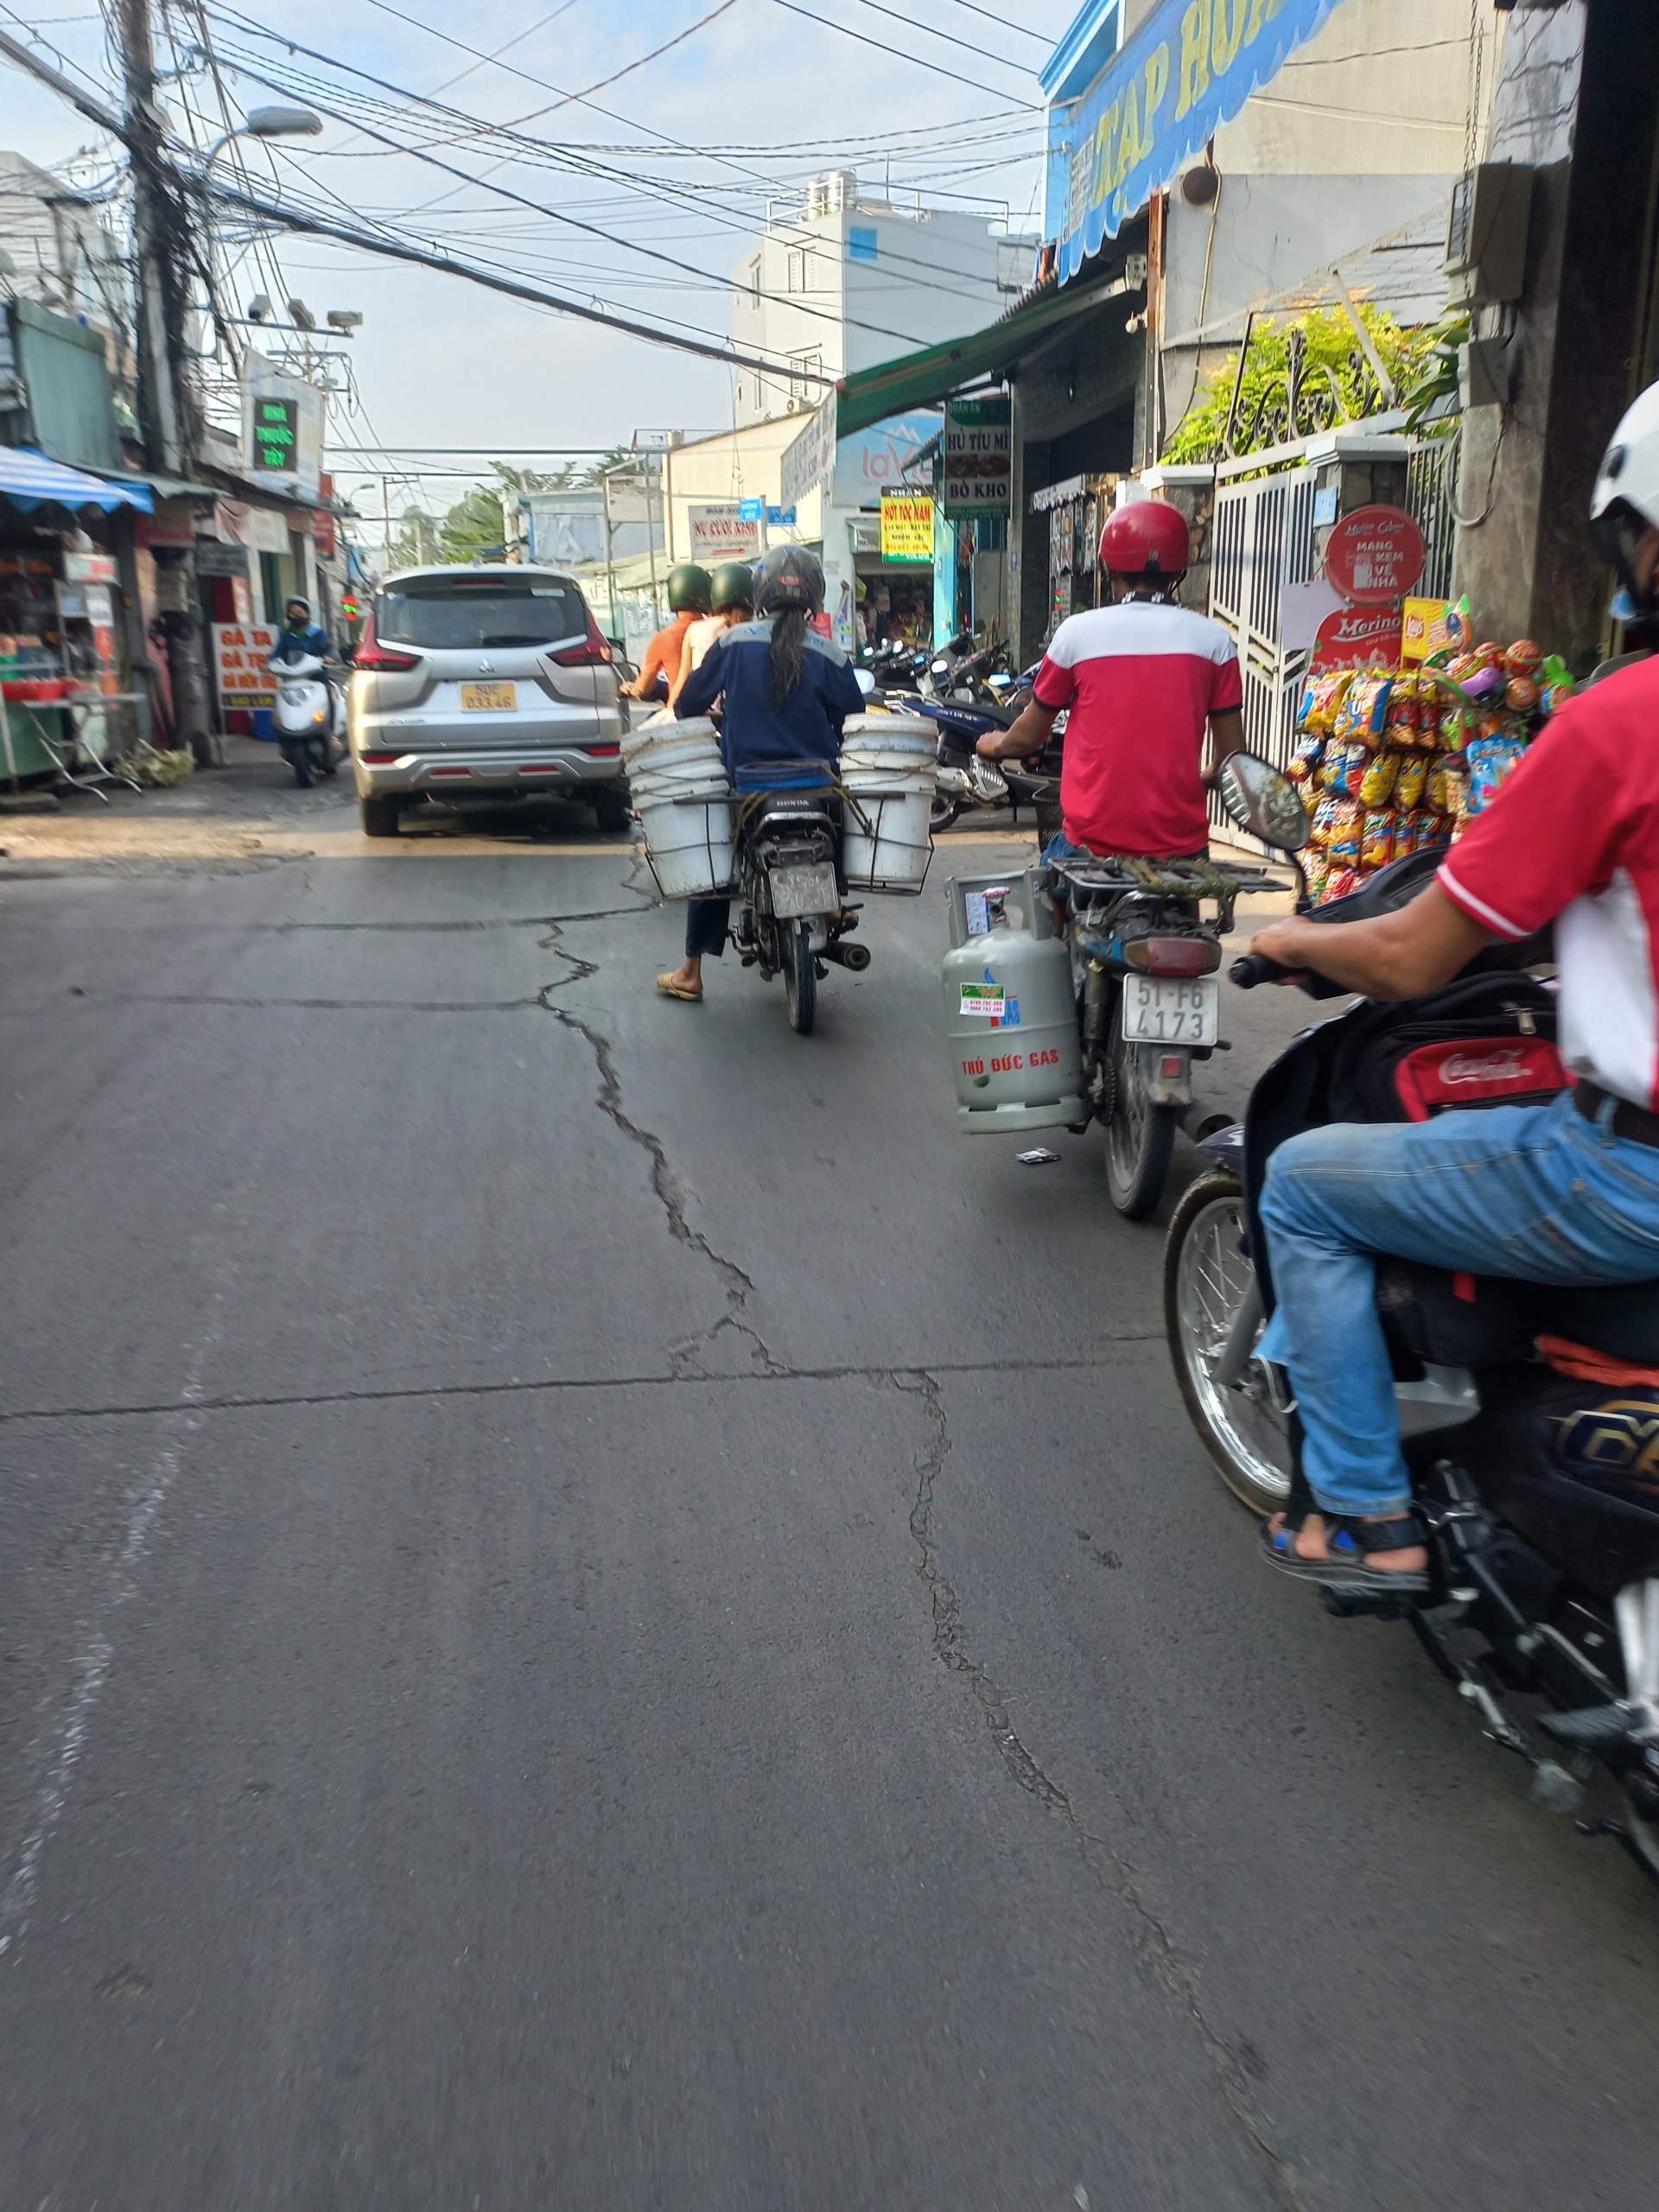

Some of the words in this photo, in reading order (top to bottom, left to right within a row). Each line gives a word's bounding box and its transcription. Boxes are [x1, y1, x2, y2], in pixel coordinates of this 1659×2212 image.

[948, 427, 965, 450] HỦ
[969, 429, 990, 450] TÍU
[995, 429, 1009, 450] MÌ
[862, 442, 934, 480] laV
[950, 477, 969, 499] BÒ
[975, 483, 1007, 499] KHO
[1356, 540, 1394, 552] MANG
[1376, 551, 1404, 563] KEM
[220, 627, 246, 646] GÀ
[251, 631, 274, 646] TA
[1335, 614, 1401, 640] Merino
[220, 650, 245, 669] GÀ
[1138, 979, 1205, 1010] 51-F6
[1135, 1008, 1205, 1040] 4173
[962, 1056, 984, 1076] THỦ
[990, 1053, 1024, 1073] ĐỨC
[1029, 1048, 1059, 1067] GAS
